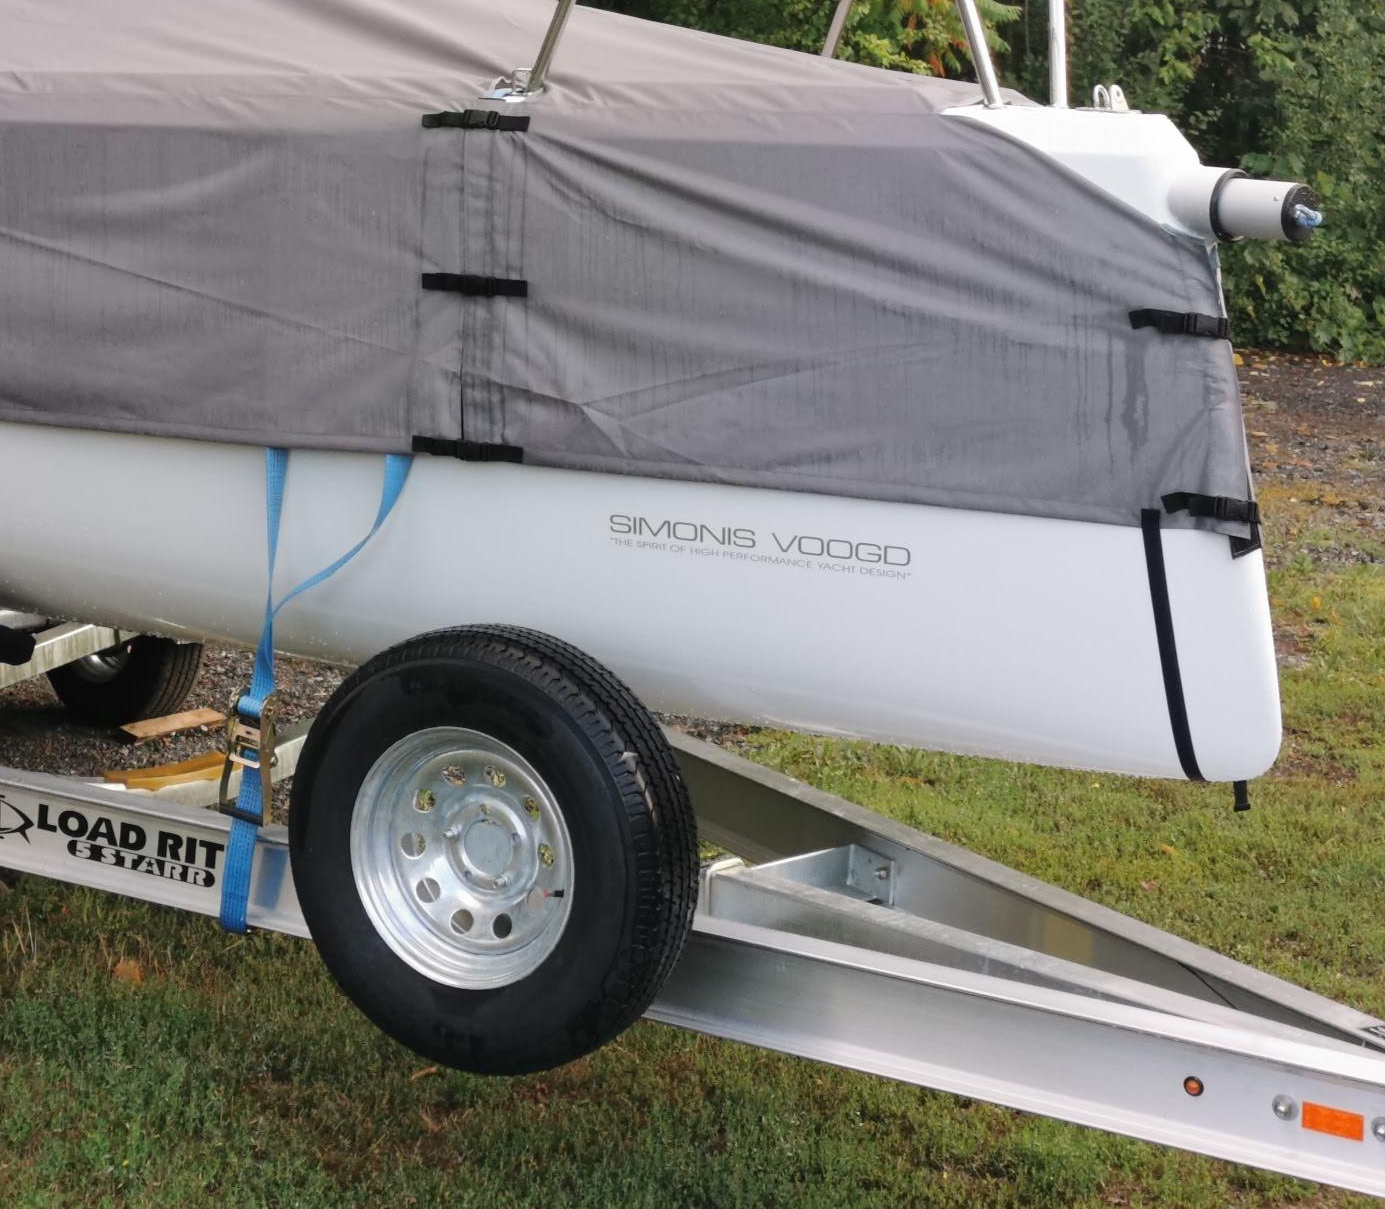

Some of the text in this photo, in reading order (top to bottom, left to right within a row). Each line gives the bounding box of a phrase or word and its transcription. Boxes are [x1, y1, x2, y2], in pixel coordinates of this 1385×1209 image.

[610, 514, 911, 567] SIMONIS VOOGD
[636, 540, 667, 551] SPIRIT
[670, 544, 687, 553] OF
[690, 546, 720, 558] HIGH
[722, 550, 814, 568] PERFORMANCE
[817, 562, 856, 574] YACHT
[37, 804, 225, 869] LOAD RIT
[75, 842, 207, 886] 5 STARR
